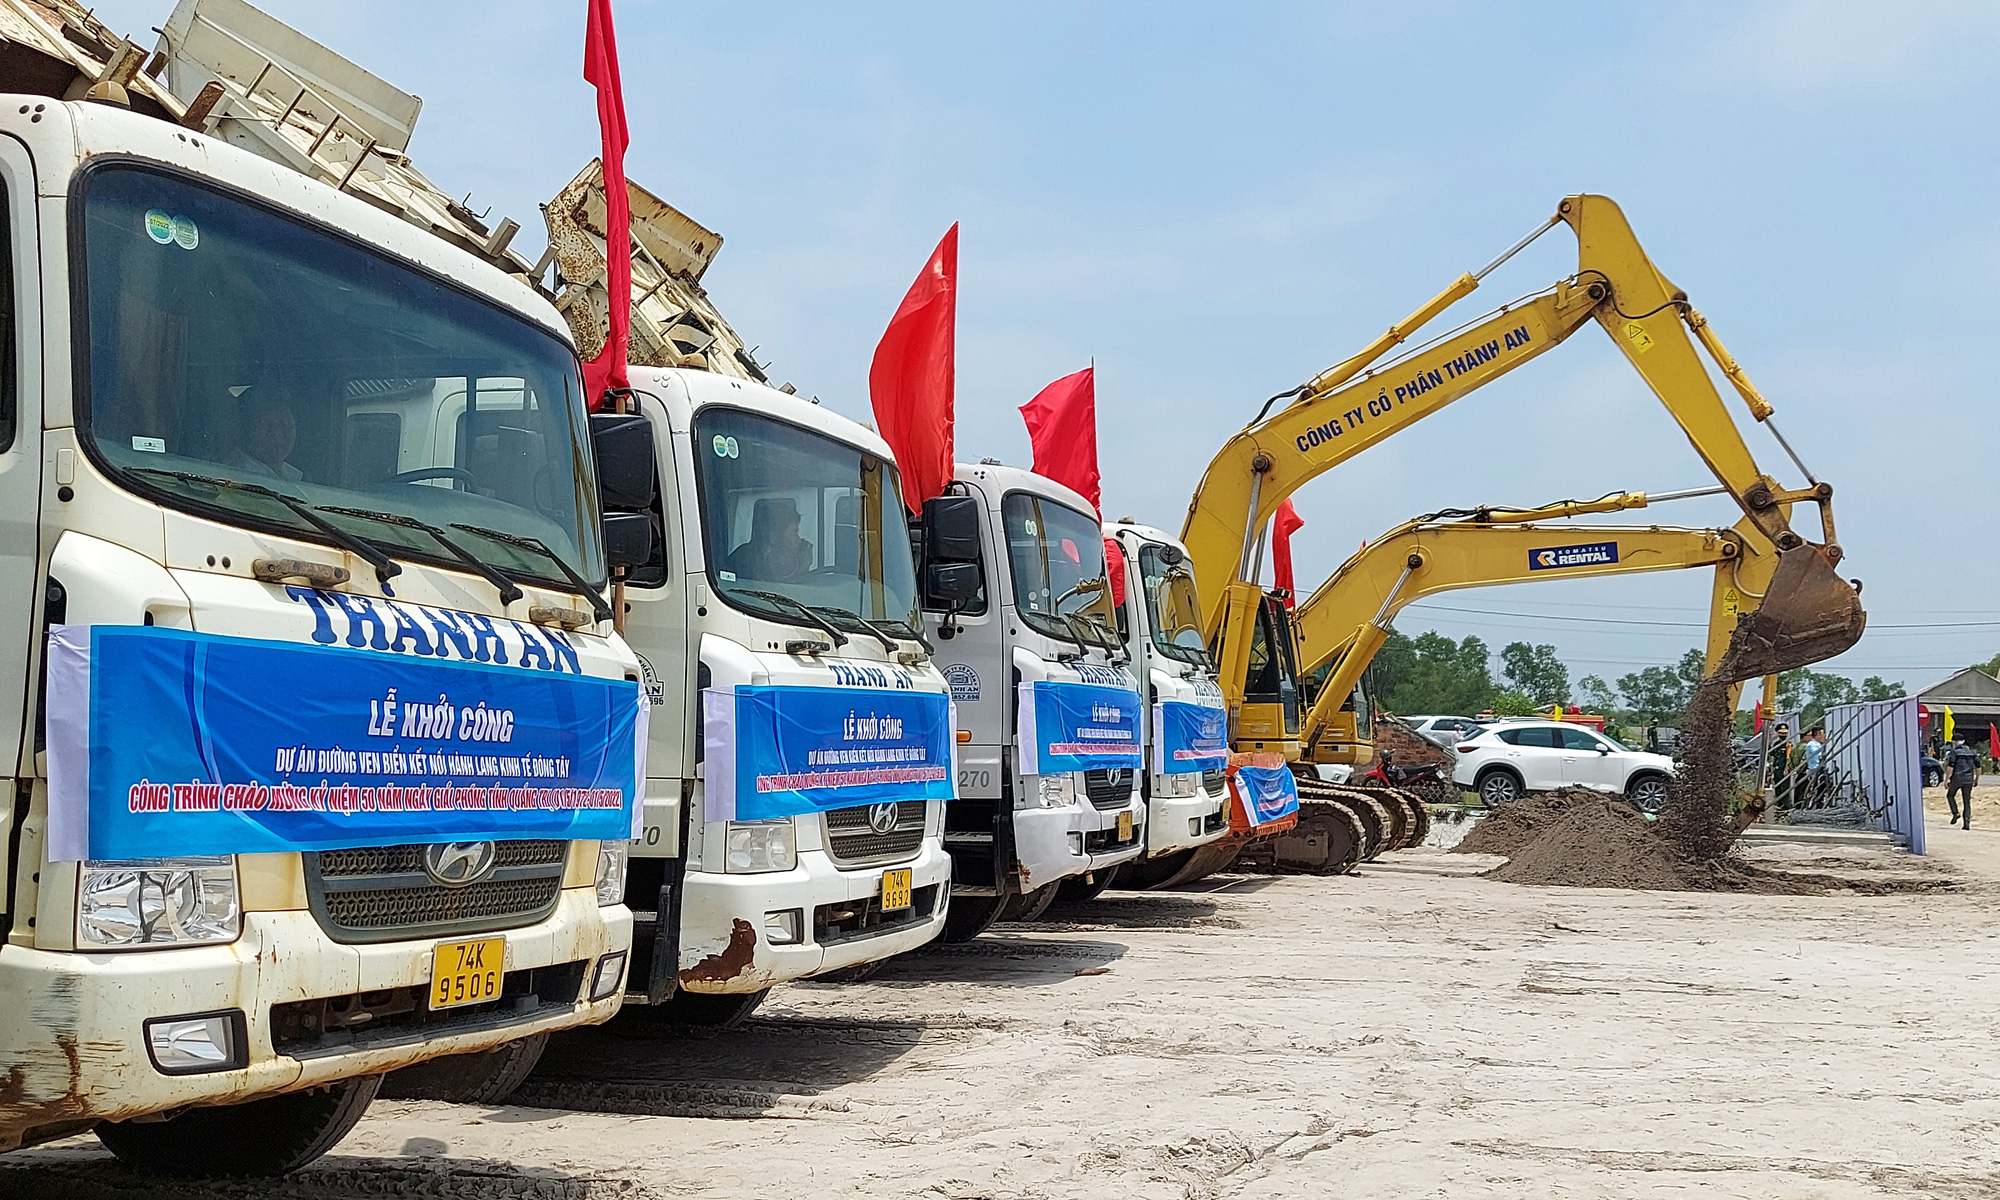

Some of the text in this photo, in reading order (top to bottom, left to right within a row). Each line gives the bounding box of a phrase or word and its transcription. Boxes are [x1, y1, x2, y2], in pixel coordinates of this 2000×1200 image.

[1296, 325, 1531, 452] CÔNG TY CỔ PHẦN THÀNH AN
[1558, 546, 1606, 554] KOMATSU
[1558, 552, 1611, 565] RENTAL
[511, 621, 582, 674] AN
[892, 669, 914, 689] AN
[367, 688, 514, 742] LỄ KHỞI CÔNG
[843, 710, 902, 740] LỄ KHỞI CÔNG
[275, 744, 570, 778] DỰ ÁN ĐƯỜNG VEN BIỂN KẾT NỐI HÀNH LANG KINH TẾ ĐÔNG TÂY
[958, 770, 990, 788] 270
[129, 779, 170, 812] CÔNG
[172, 779, 221, 812] TRÌNH
[222, 781, 269, 812] CHÀO
[267, 781, 312, 811] MỪNG
[327, 782, 360, 816] NIỆM
[361, 787, 376, 812] 50
[376, 782, 404, 811] NĂM
[404, 783, 433, 811] NGÀY
[433, 781, 455, 810] GIẢI
[454, 783, 487, 810] PHÓNG
[488, 781, 509, 810] TỈNH
[508, 782, 538, 812] QUẢNG
[892, 871, 904, 888] 74K
[885, 889, 908, 908] 9692
[456, 942, 486, 972] 74K
[439, 971, 495, 1003] 9506
